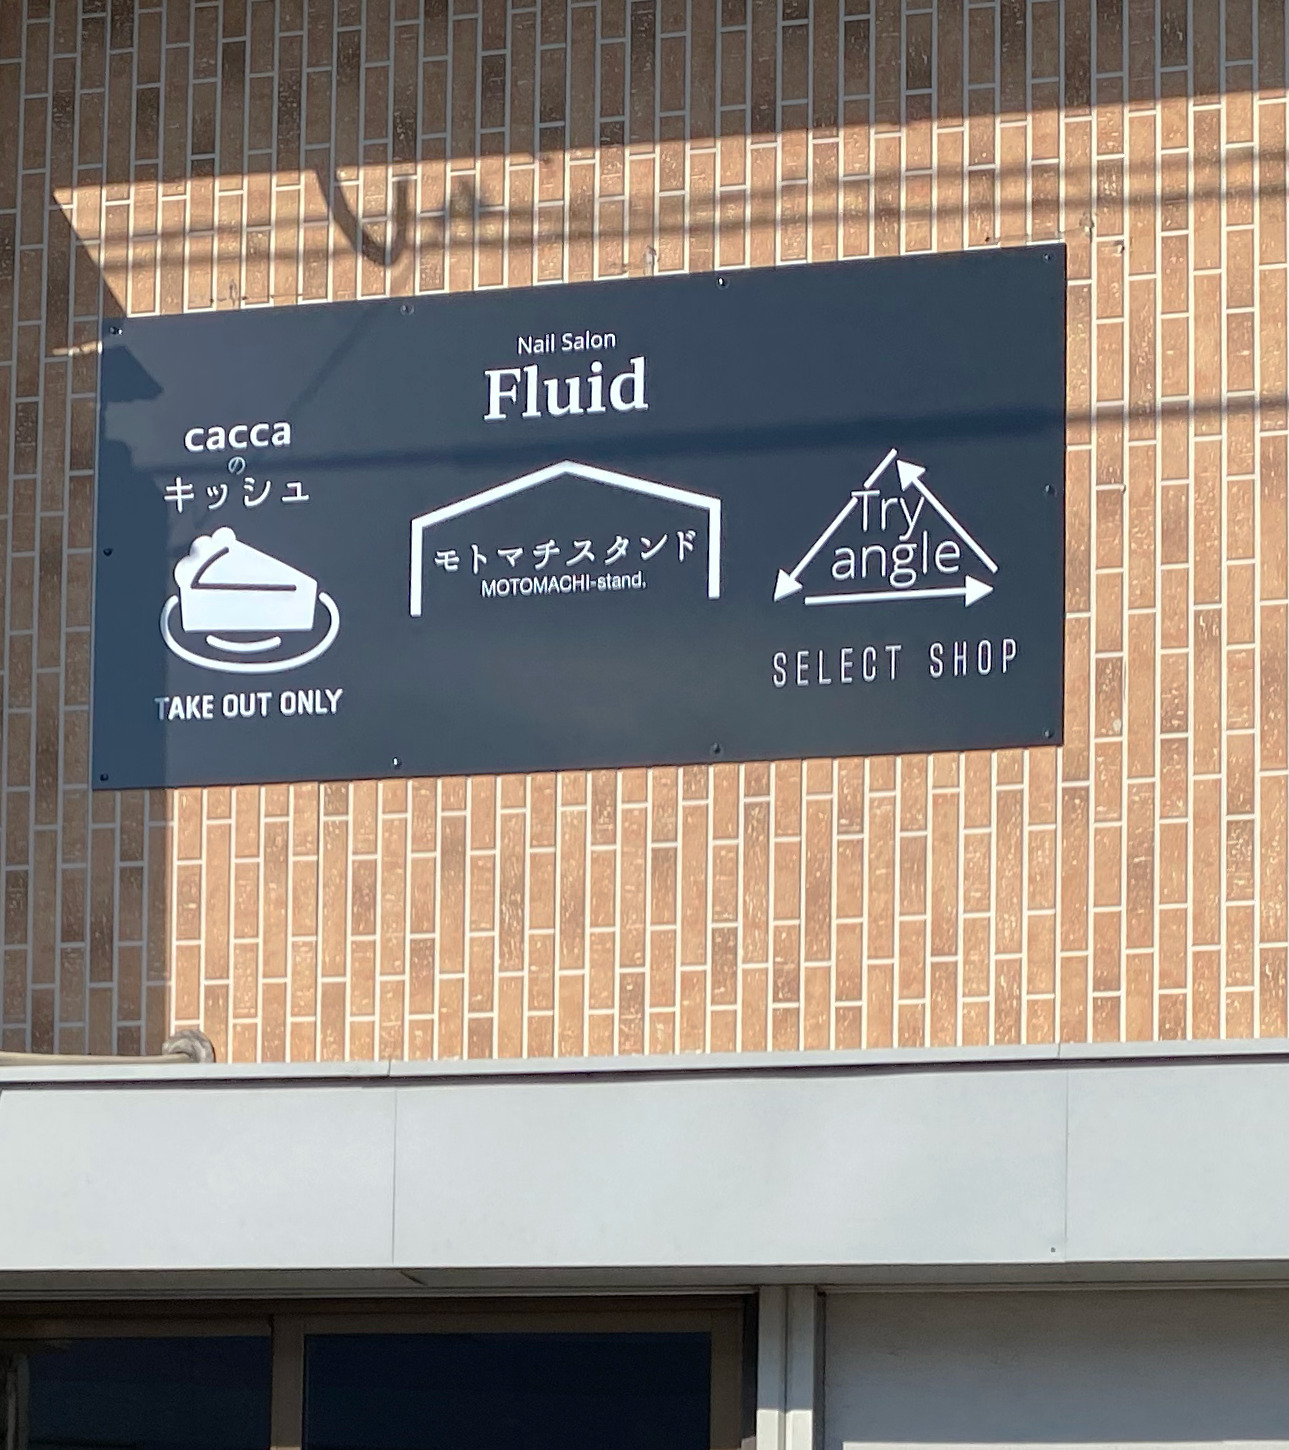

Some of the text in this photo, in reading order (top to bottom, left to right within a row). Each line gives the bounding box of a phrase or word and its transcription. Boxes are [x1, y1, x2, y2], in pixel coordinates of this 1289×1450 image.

[517, 330, 616, 355] Nail Salon
[483, 356, 649, 422] Fluid
[184, 420, 292, 451] cacca
[227, 455, 247, 475] の
[164, 476, 310, 513] キッシュ
[850, 489, 925, 541] Try
[433, 529, 697, 575] モトマチスタンド
[831, 530, 961, 590] angle
[481, 571, 647, 598] MOTOMACHI-stand.
[772, 638, 1018, 687] SELECT SHOP
[157, 689, 343, 720] TAKE OUT ONLY
